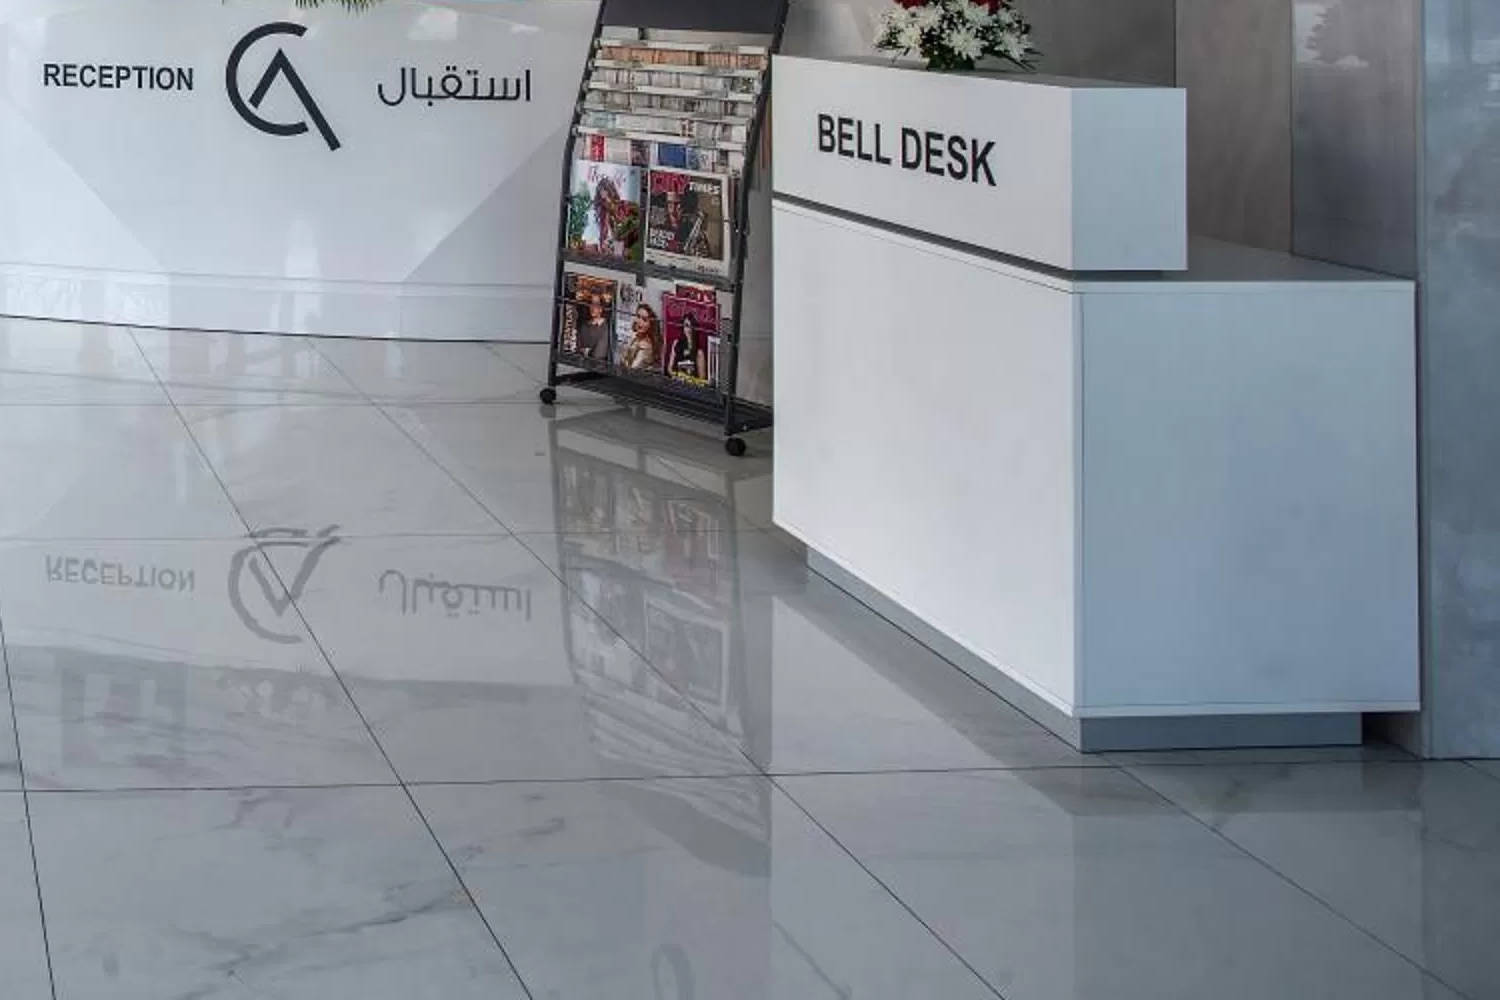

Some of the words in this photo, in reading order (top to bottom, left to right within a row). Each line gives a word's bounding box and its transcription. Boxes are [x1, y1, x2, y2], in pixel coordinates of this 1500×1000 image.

[43, 63, 194, 91] RECEPTION
[377, 65, 532, 106] استقبال
[818, 113, 892, 165] BELL
[901, 127, 997, 187] DESK
